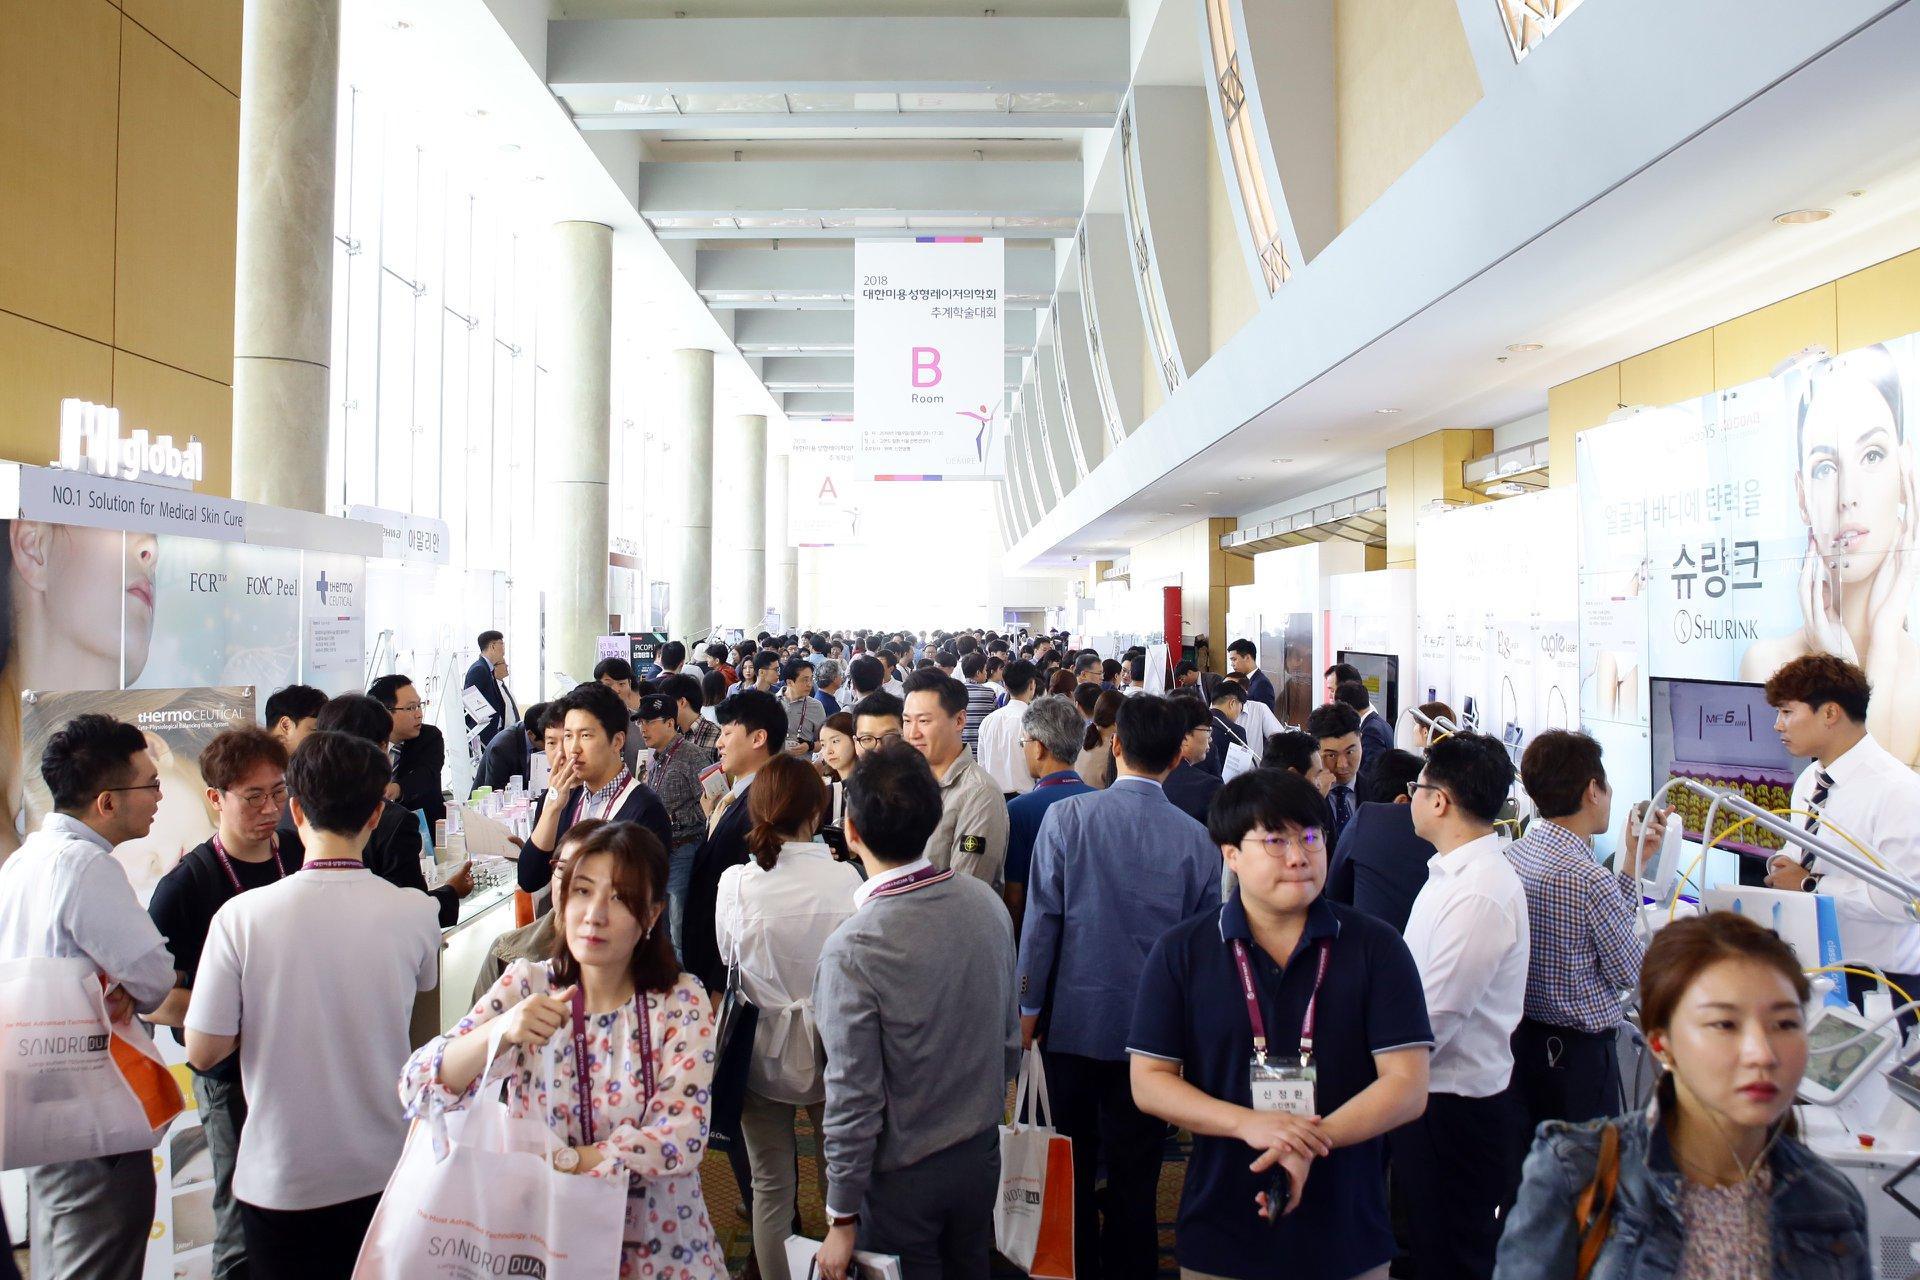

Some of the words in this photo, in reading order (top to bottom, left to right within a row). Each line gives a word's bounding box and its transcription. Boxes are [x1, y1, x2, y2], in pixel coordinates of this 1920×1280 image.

[863, 275, 888, 286] 2018
[931, 306, 997, 319] 추계학술대회
[912, 346, 943, 388] B
[911, 393, 944, 404] Room
[818, 476, 838, 498] A
[53, 485, 82, 507] NO.1
[88, 490, 135, 514] Solution
[140, 497, 155, 516] for
[159, 501, 197, 521] Medical
[201, 507, 220, 525] Skin
[223, 510, 243, 528] Cure
[1670, 537, 1763, 600] 슈링크
[276, 578, 299, 597] Peel
[1694, 613, 1759, 640] SHURINK
